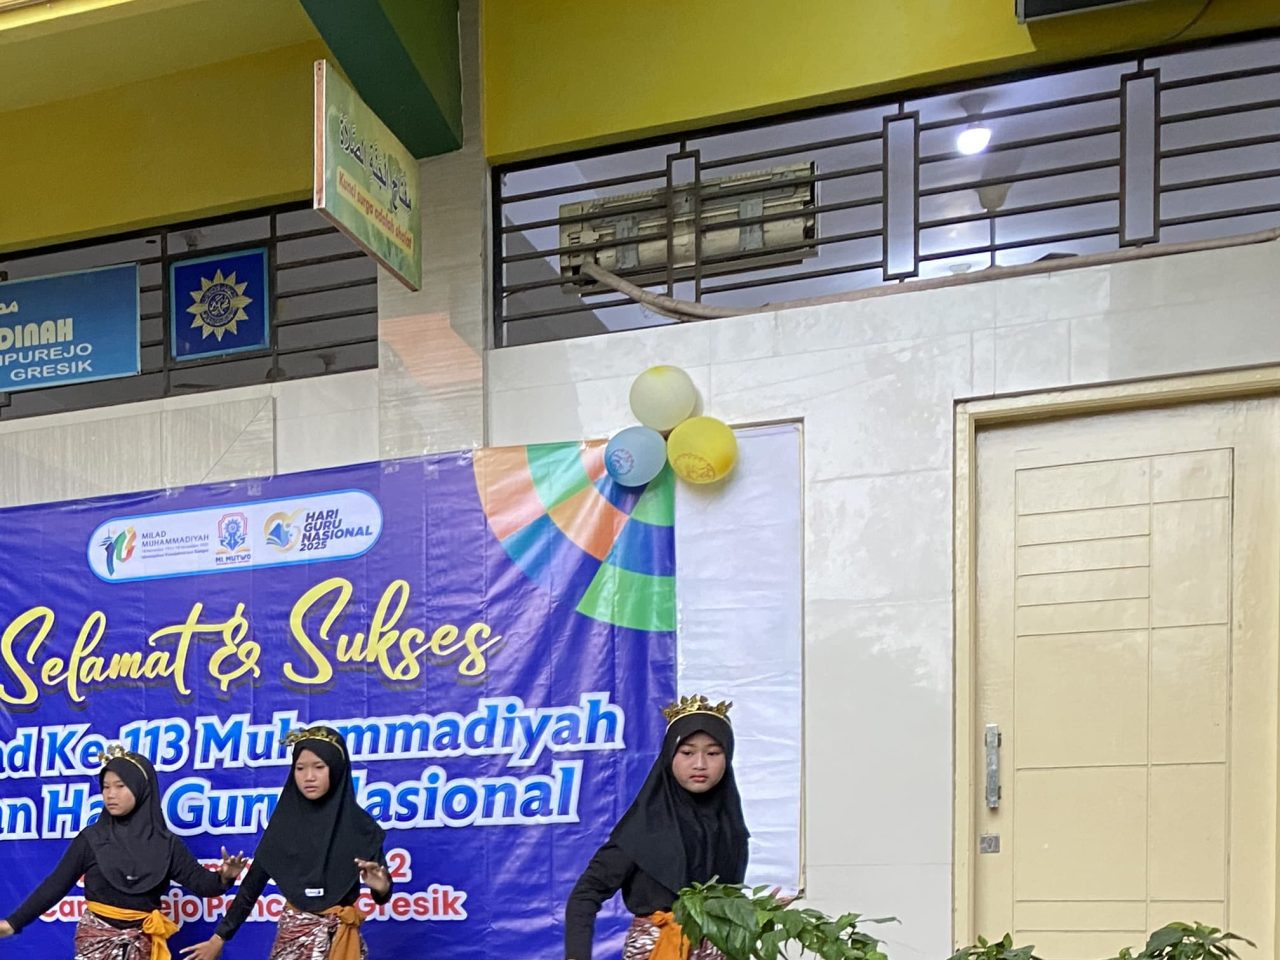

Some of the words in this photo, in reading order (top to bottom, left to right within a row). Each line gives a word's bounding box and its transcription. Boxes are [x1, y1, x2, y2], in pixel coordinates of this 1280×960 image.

[10, 359, 93, 381] GRESIK
[305, 509, 339, 522] HARI
[301, 525, 373, 543] NASIONAL
[304, 518, 342, 532] GURU
[141, 530, 166, 540] MILAD
[141, 534, 209, 547] MUHAMMADIYAH
[299, 540, 327, 551] 2025
[209, 602, 261, 692] &
[282, 577, 503, 684] Sukses
[201, 698, 619, 766] Mummadiyah
[352, 765, 578, 825] asional
[389, 852, 407, 878] 2
